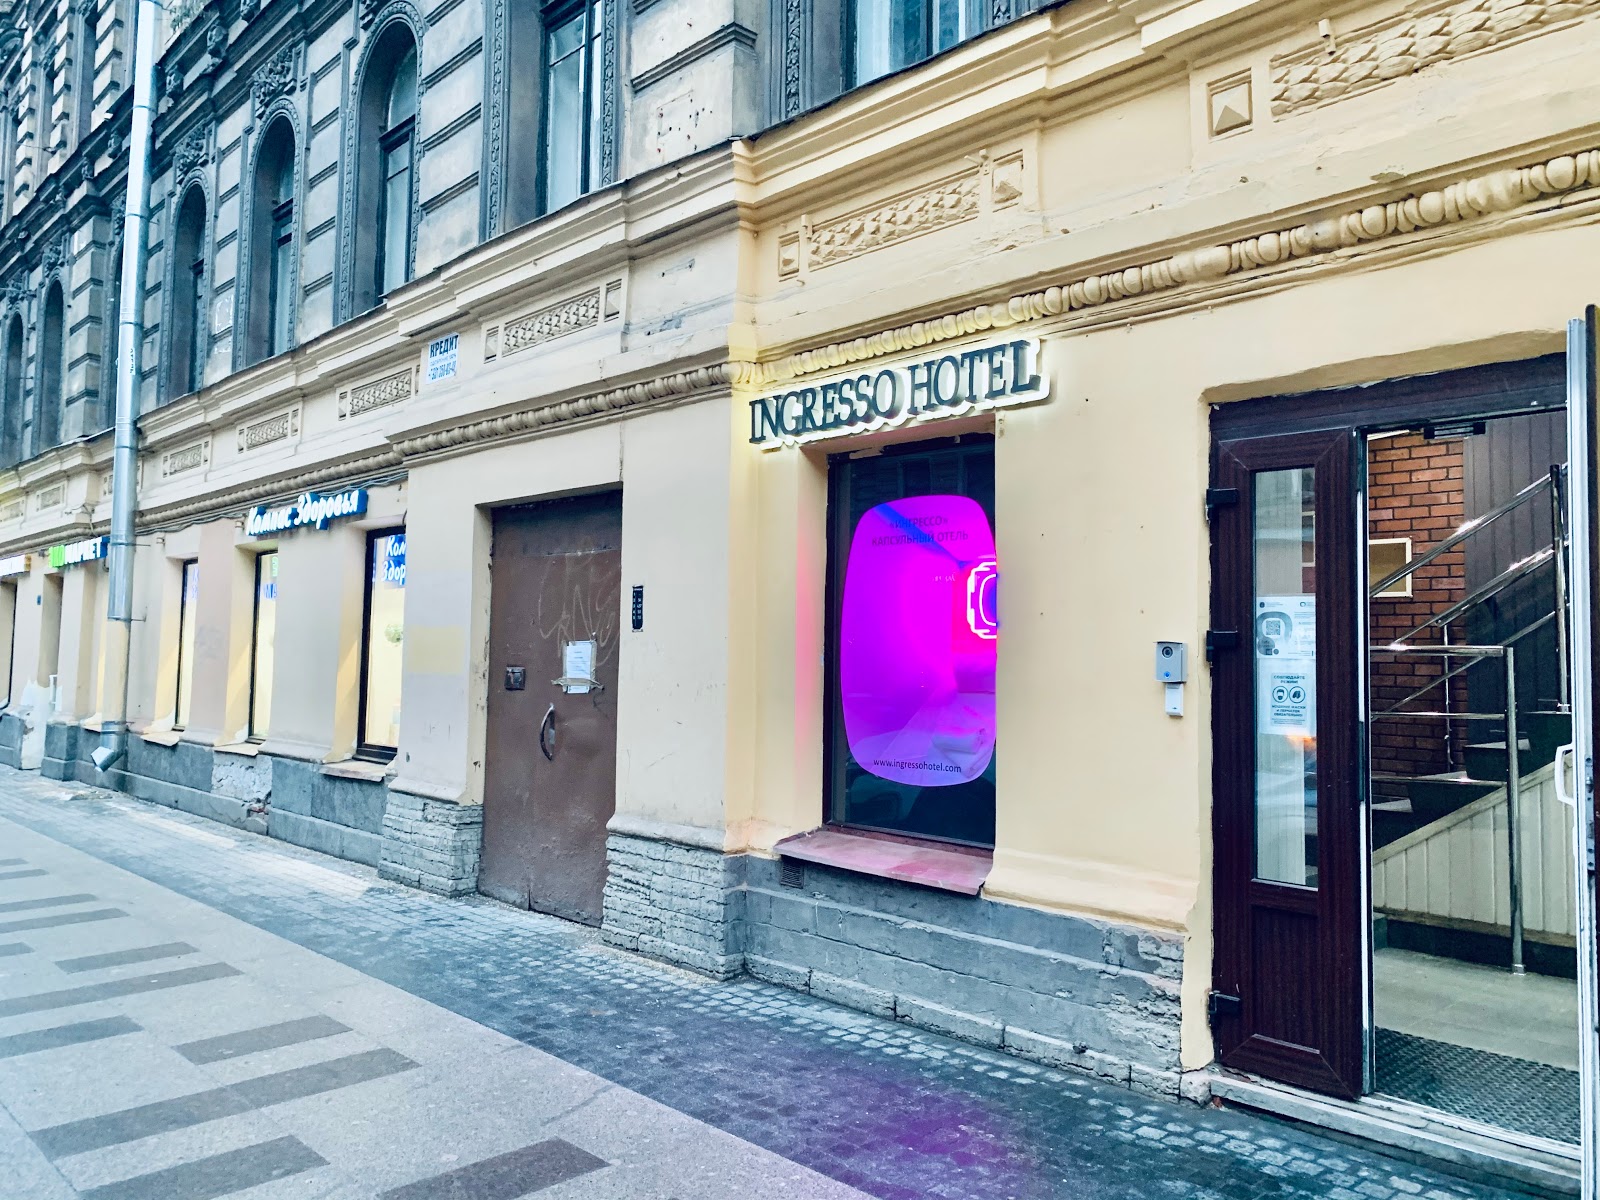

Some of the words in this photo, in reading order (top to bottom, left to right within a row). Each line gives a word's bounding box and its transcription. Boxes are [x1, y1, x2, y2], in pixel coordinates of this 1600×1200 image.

[429, 335, 459, 359] КРЕДИТ
[748, 369, 902, 443] INGRESSO
[906, 339, 1041, 415] HOTEL
[246, 505, 292, 536] Компас
[293, 489, 360, 530] Здоровья
[871, 531, 935, 546] КАПСУЛЬНЫЙ
[937, 530, 969, 543] ОТЕЛЬ
[873, 758, 962, 773] www.ingressohotel.com
